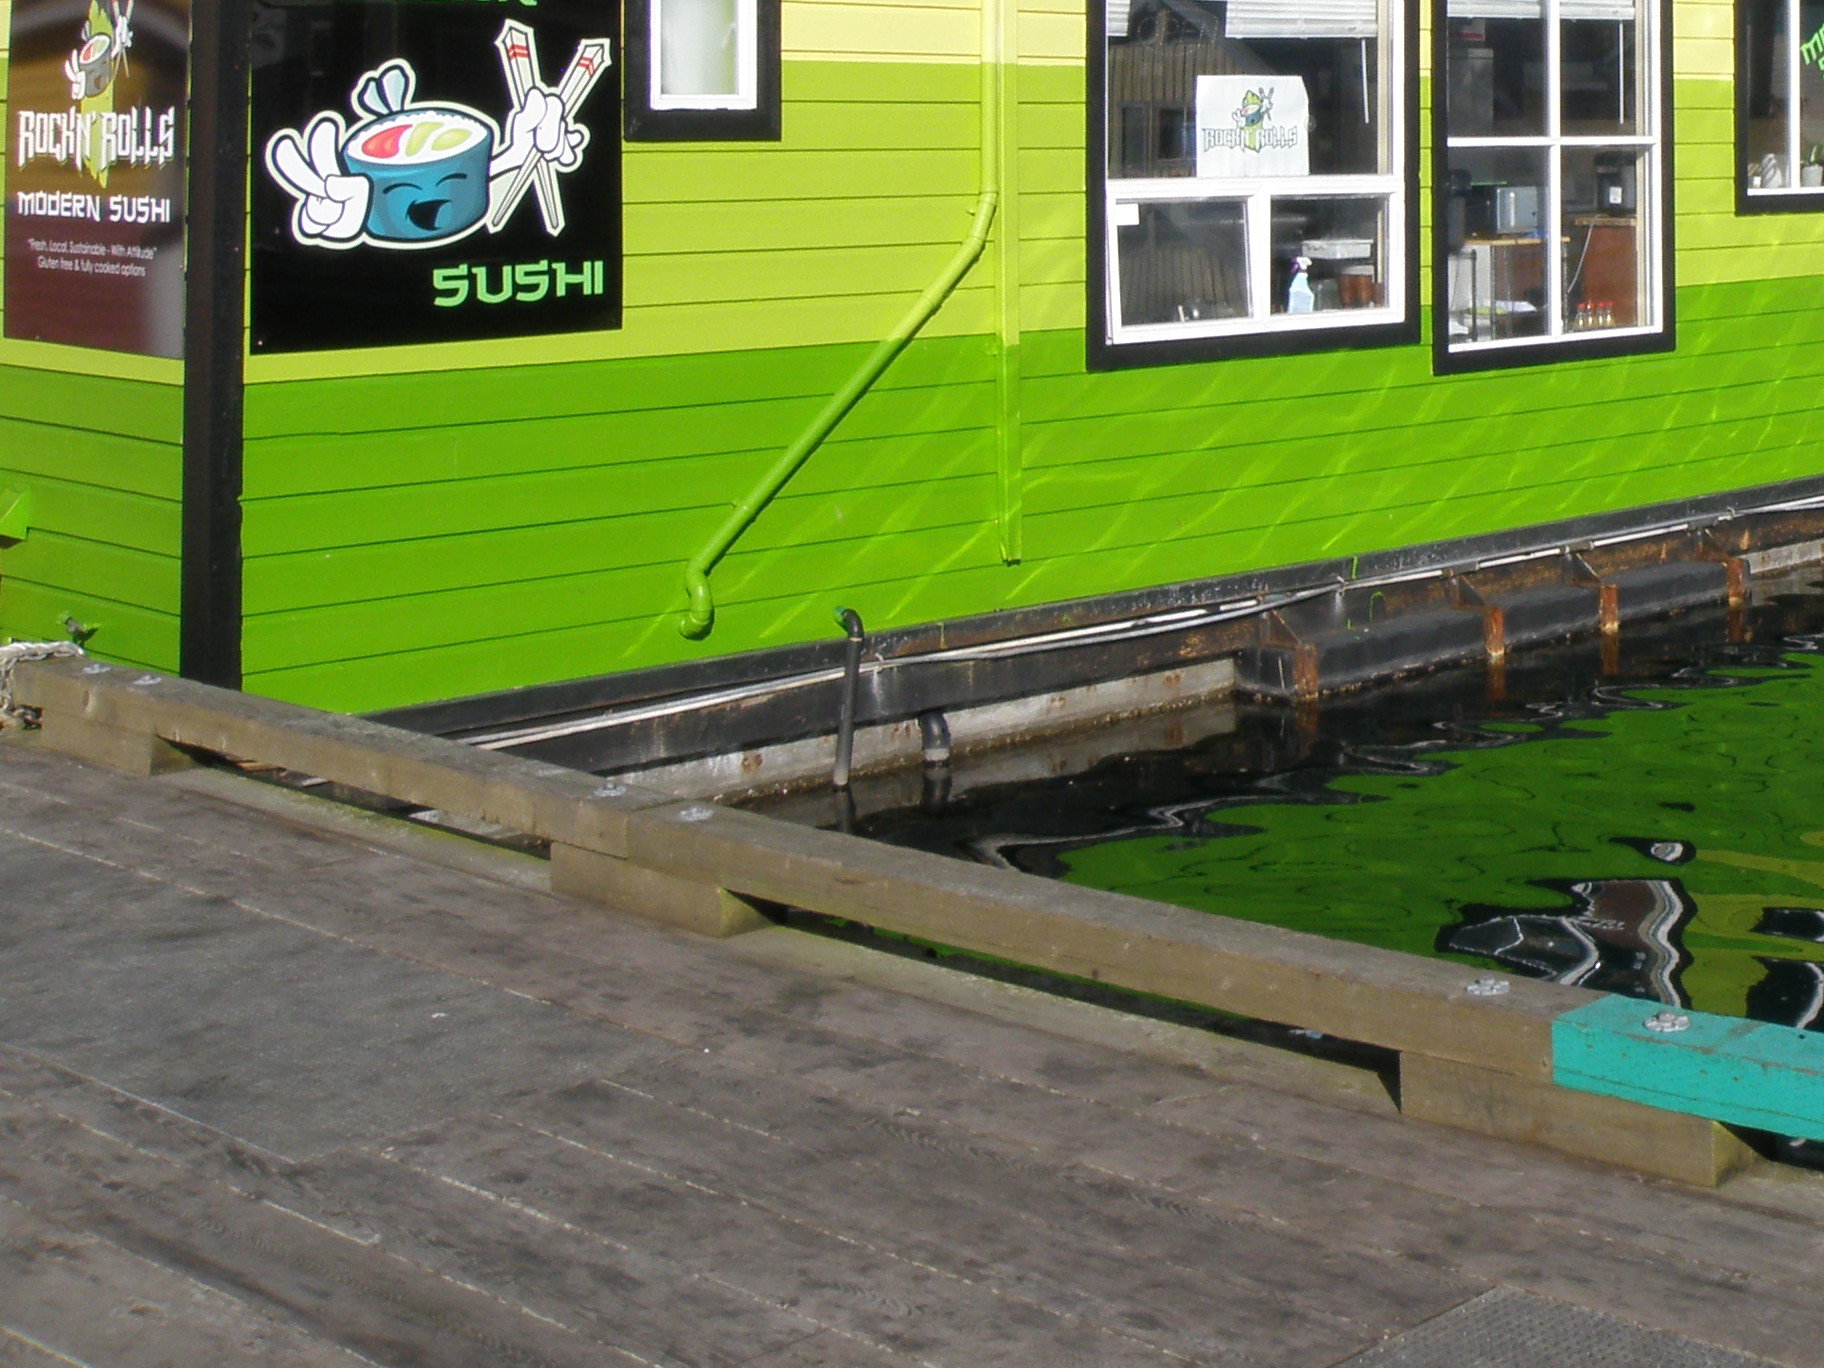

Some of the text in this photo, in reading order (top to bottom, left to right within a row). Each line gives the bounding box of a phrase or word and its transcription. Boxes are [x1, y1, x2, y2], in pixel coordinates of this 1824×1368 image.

[99, 106, 175, 170] ROLLS
[1254, 125, 1298, 153] ROLLS
[18, 190, 171, 224] MODERN SUSHI
[37, 255, 146, 277] Gluten free & fully cooked options
[111, 244, 125, 257] With
[433, 259, 604, 307] SUSHI
